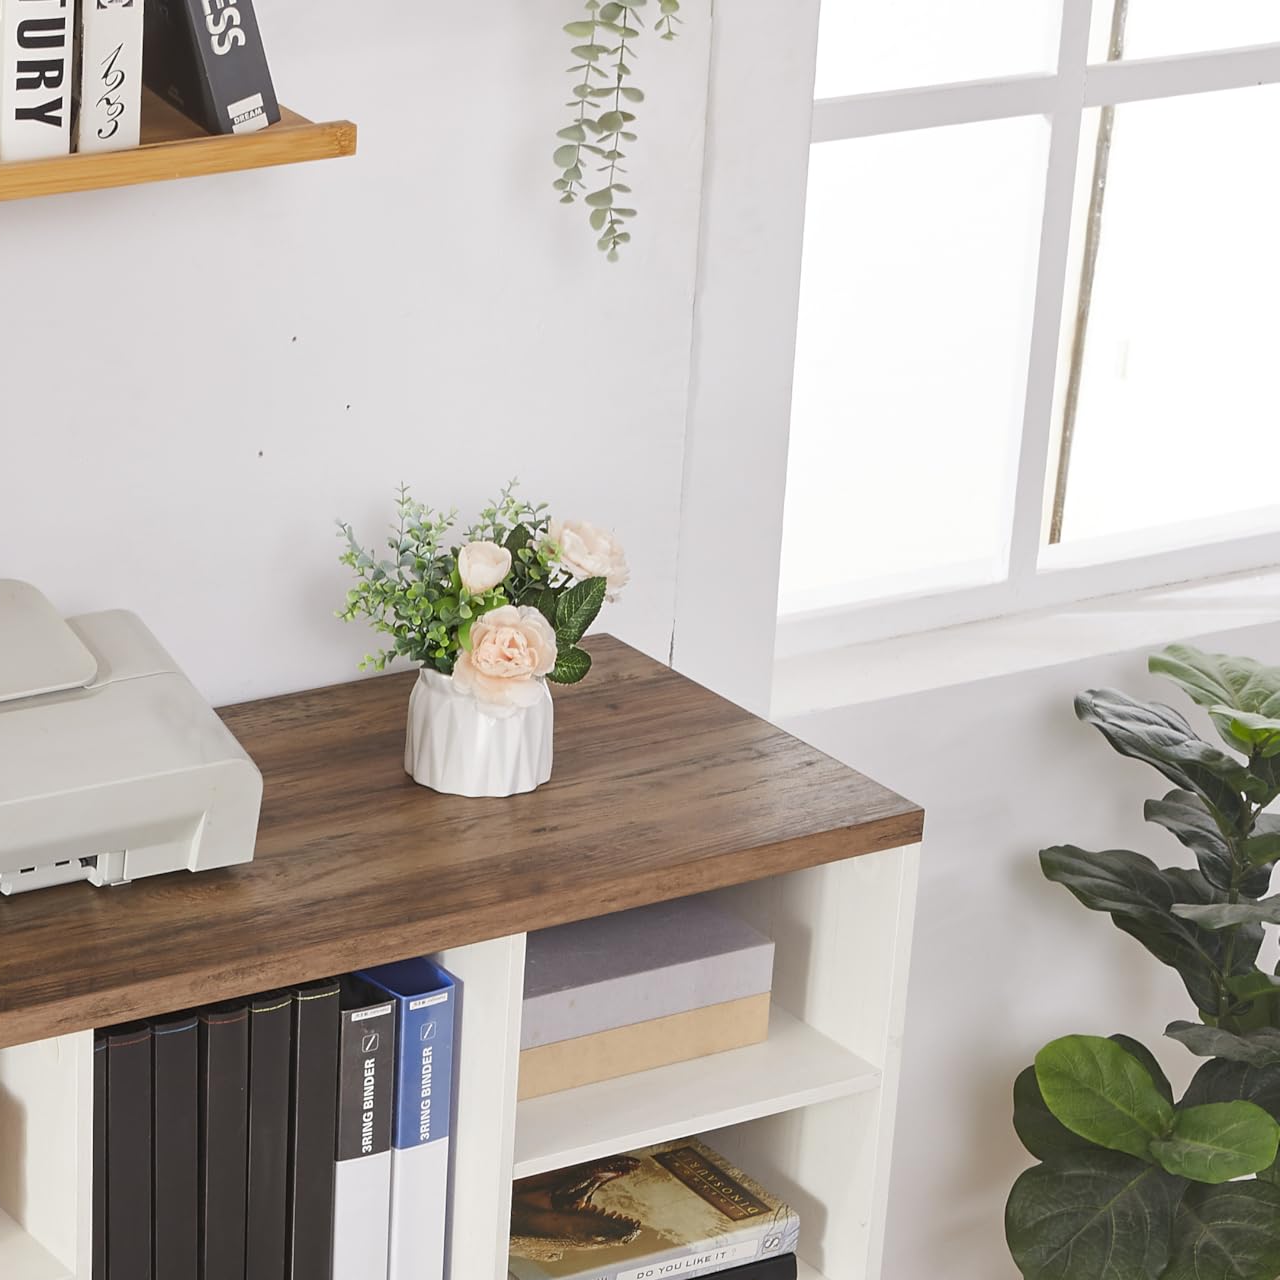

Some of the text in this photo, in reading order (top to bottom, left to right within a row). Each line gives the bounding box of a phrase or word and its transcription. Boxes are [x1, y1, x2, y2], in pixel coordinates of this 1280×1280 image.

[233, 107, 263, 124] DREAM
[362, 1057, 375, 1153] 3RING BINDER
[420, 1046, 433, 1141] 3RING BINDER
[636, 1251, 728, 1280] DO YOU LIKE IT
